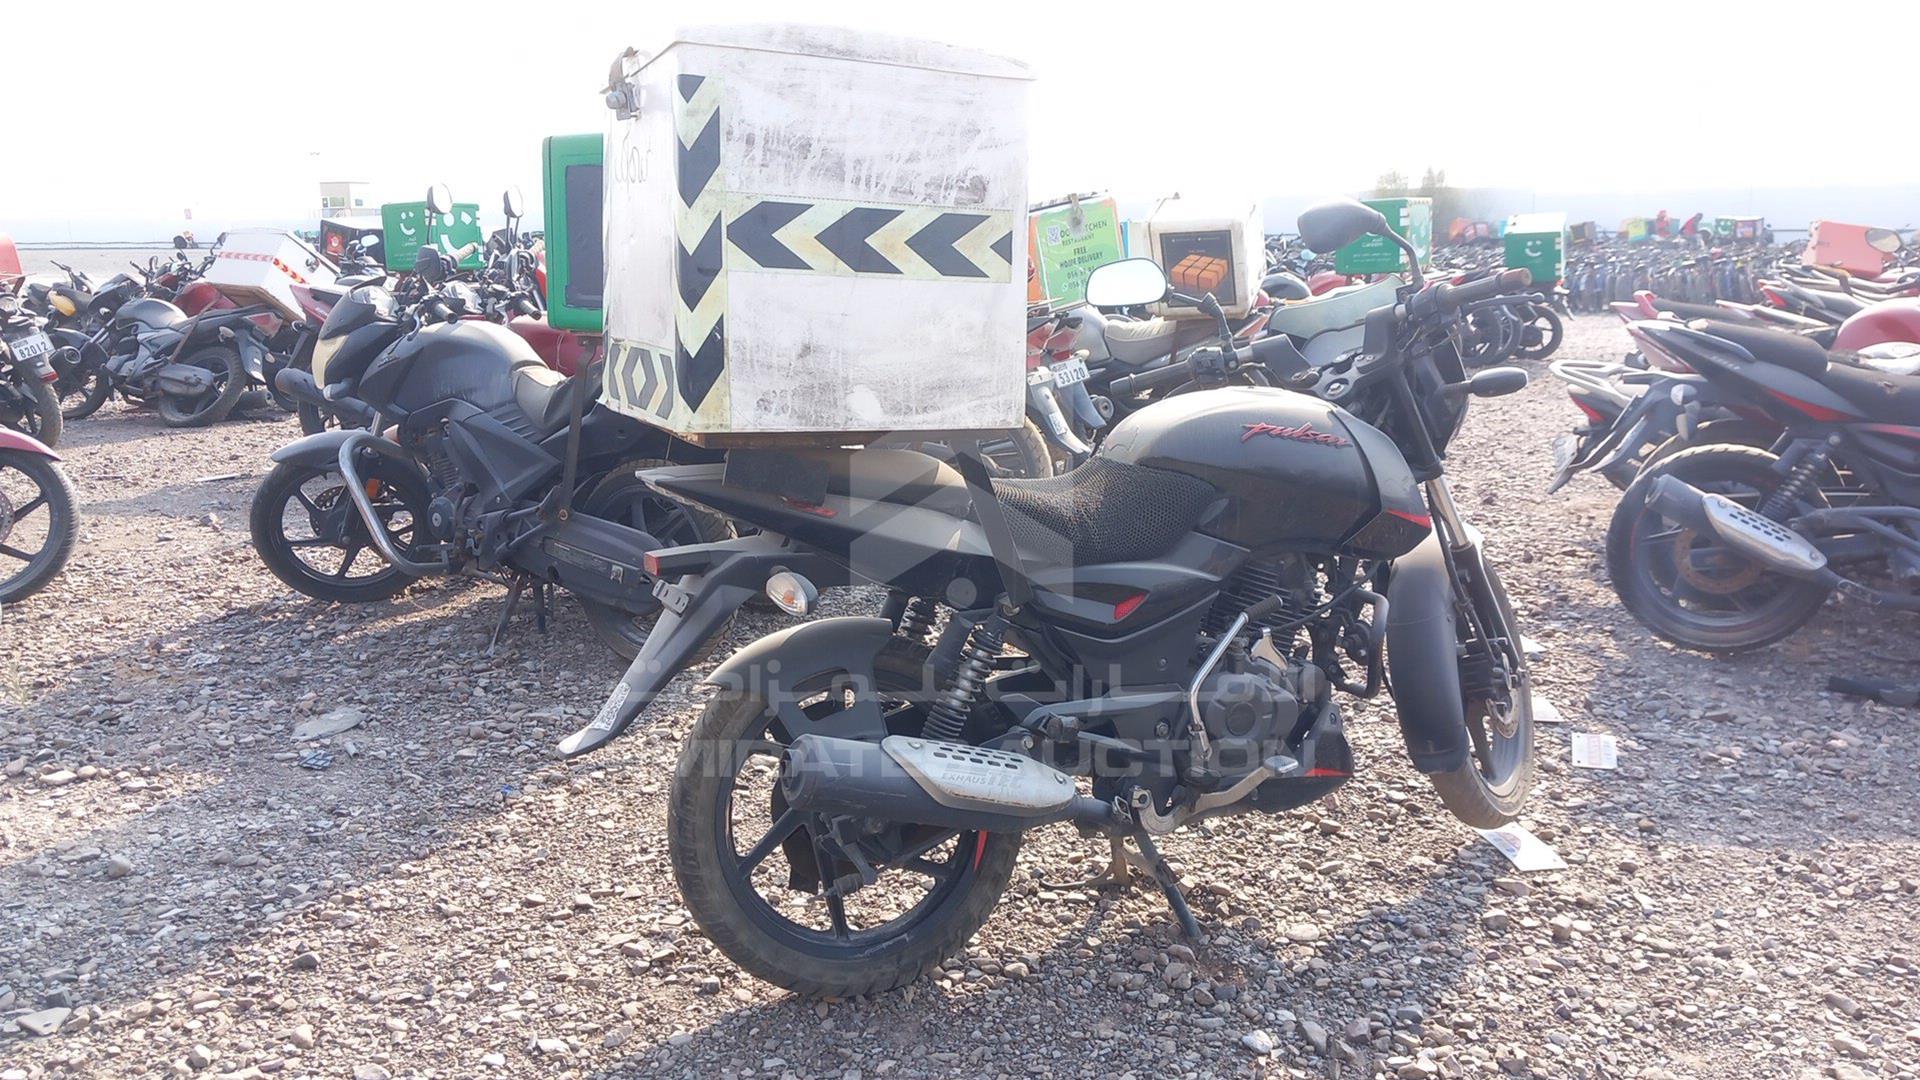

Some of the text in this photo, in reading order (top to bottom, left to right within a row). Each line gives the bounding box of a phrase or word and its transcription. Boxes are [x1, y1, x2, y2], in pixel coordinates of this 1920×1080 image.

[1073, 246, 1087, 256] FREE
[1078, 251, 1103, 264] DELIVERY
[19, 341, 48, 359] 82012
[1058, 367, 1086, 385] 53120
